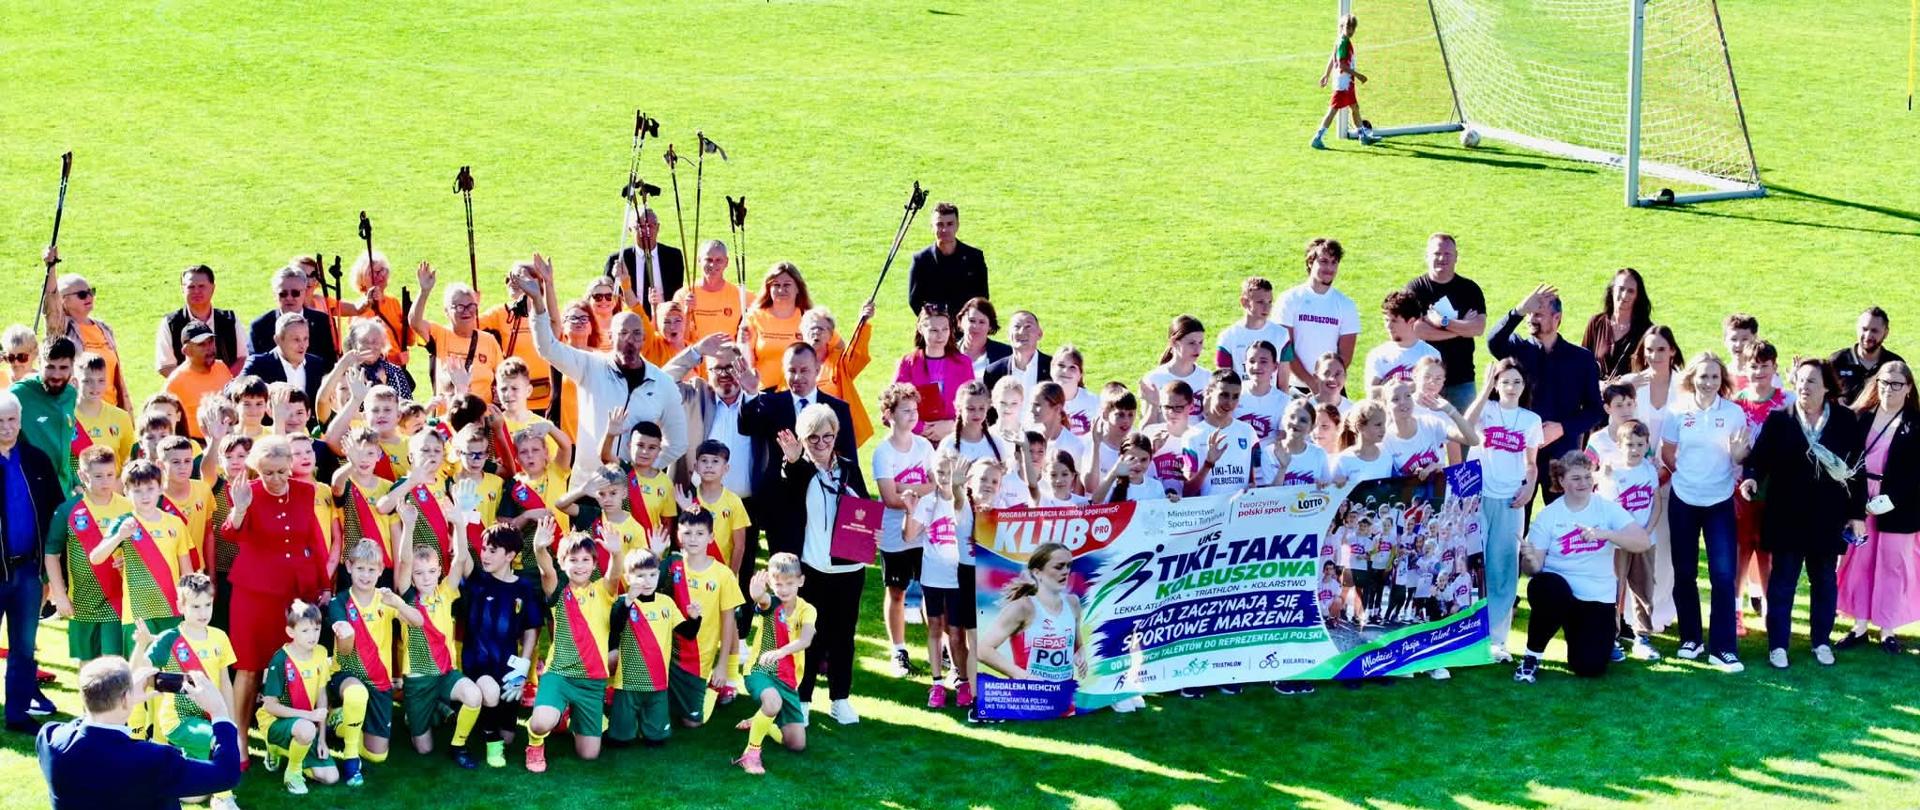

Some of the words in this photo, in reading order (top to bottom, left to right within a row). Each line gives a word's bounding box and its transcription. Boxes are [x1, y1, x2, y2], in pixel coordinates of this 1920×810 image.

[1238, 509, 1263, 518] polski
[1264, 505, 1286, 515] sport
[1298, 498, 1323, 510] LOTTO
[994, 518, 1089, 553] KLUB
[1094, 524, 1110, 535] PRO
[1198, 530, 1222, 546] UKS
[1157, 534, 1319, 582] TIKI-TAKA
[1114, 603, 1142, 615] LEKKA
[1195, 585, 1239, 597] TRIATHLON
[1251, 579, 1307, 589] KOLARSTWO
[1155, 560, 1315, 600] KOLBUSZOWA
[1121, 618, 1210, 652] SPORTOWE
[1213, 609, 1304, 632] MARZENIA
[1132, 608, 1176, 632] TUTAJ
[1177, 594, 1266, 621] ZACZYNAJĄ
[1273, 594, 1300, 609] SIĘ
[1034, 638, 1066, 649] SPAR
[1036, 649, 1070, 667] POL
[1110, 660, 1123, 670] OD
[1204, 639, 1216, 649] DO
[1290, 630, 1323, 640] POLSKI
